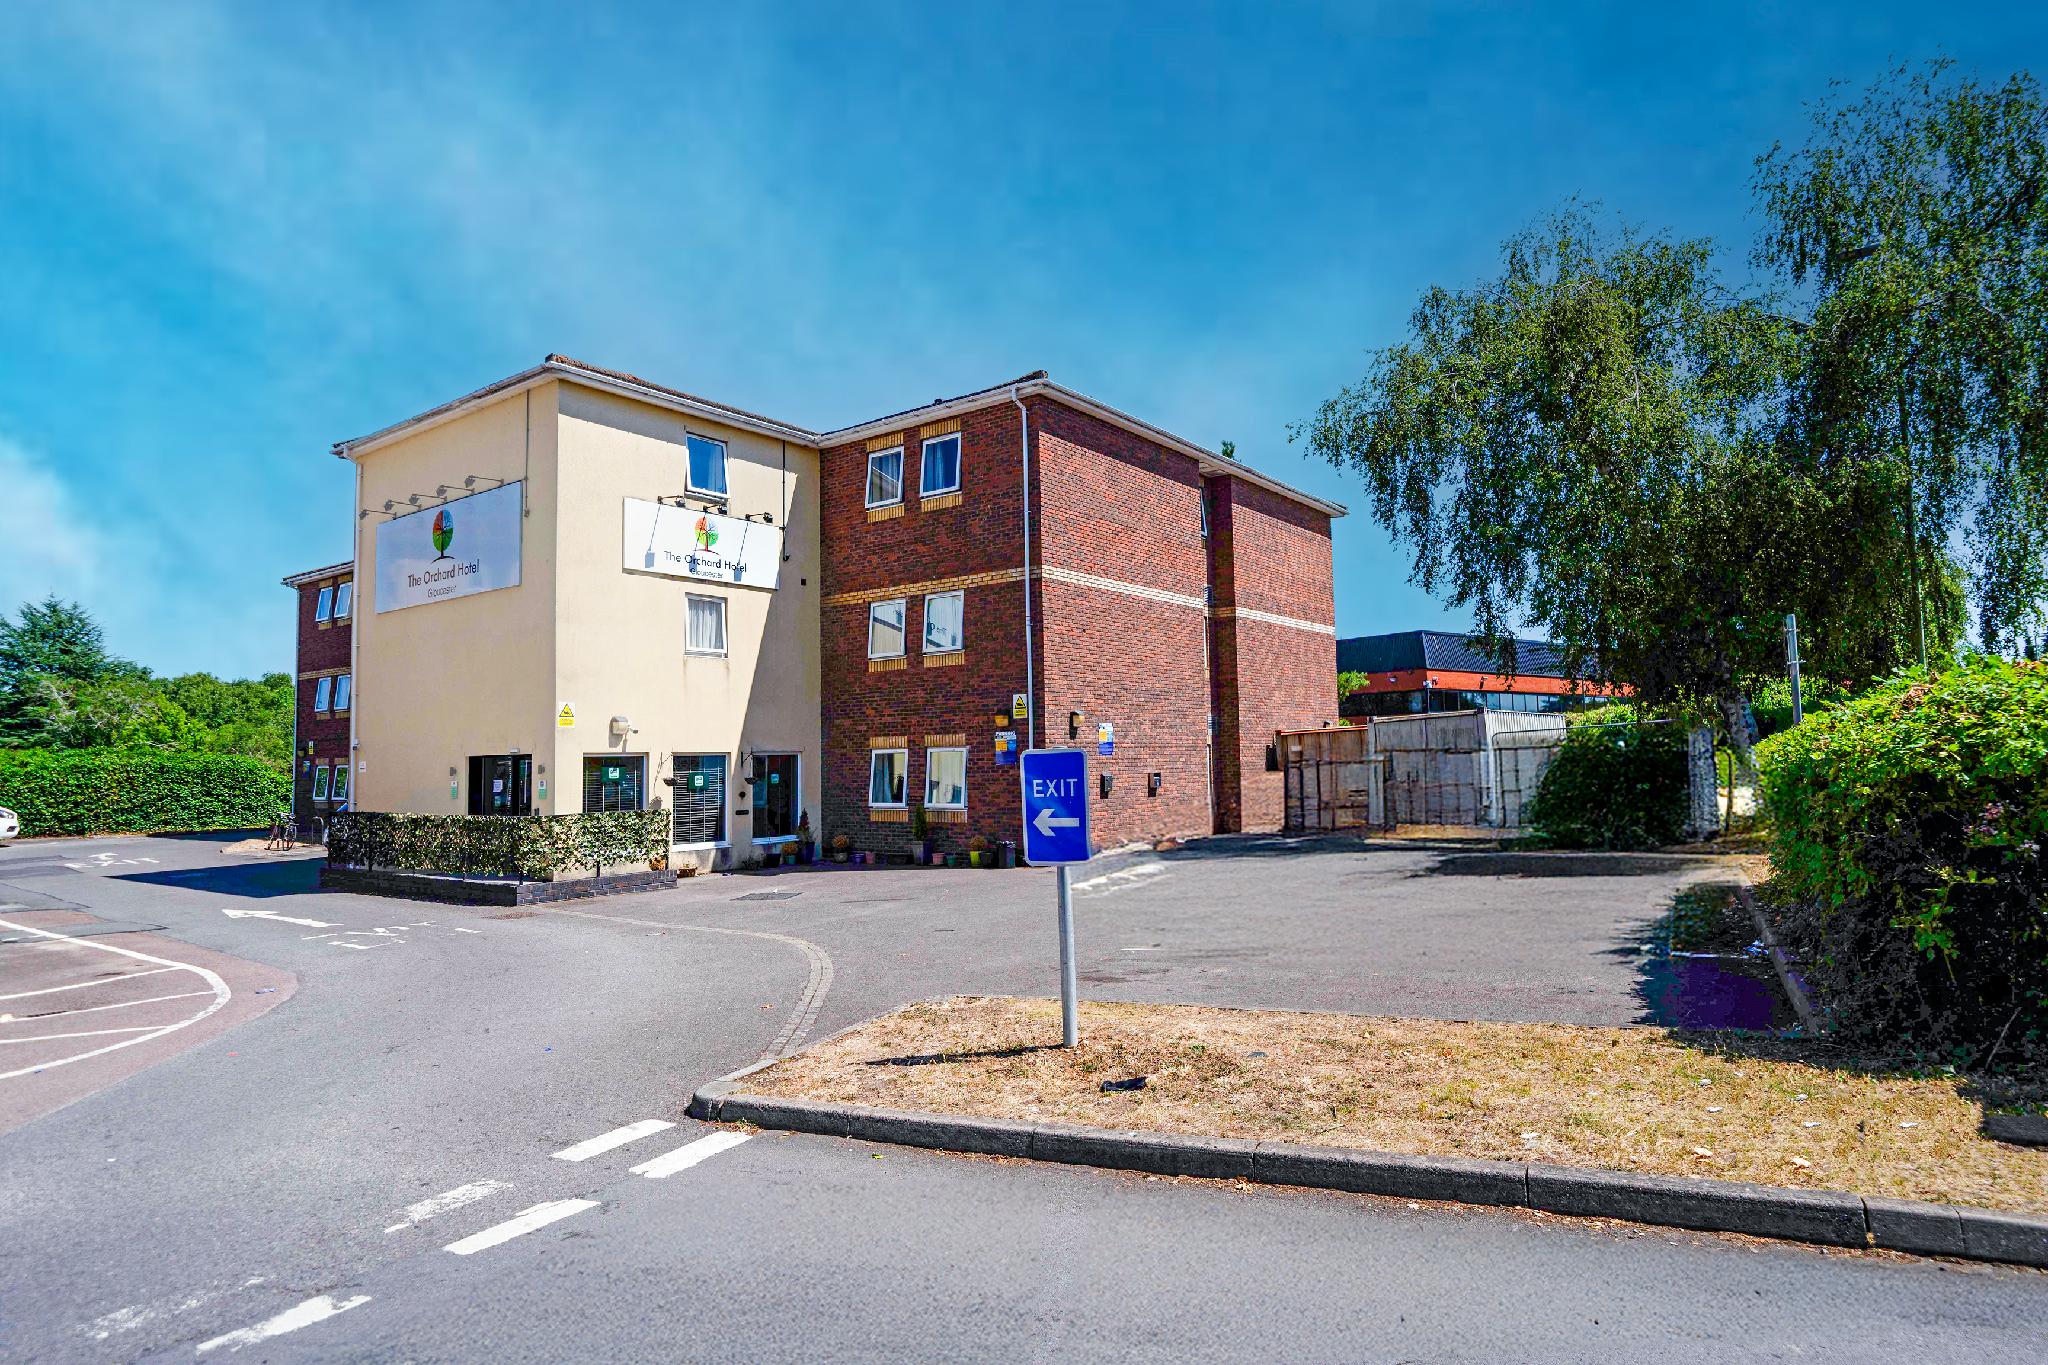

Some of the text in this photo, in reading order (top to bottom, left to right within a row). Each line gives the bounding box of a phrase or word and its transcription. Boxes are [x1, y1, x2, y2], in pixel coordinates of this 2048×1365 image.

[407, 558, 480, 588] The Orchard Hotel
[664, 550, 747, 573] The Orchard Hotel
[1033, 778, 1078, 798] EXIT
